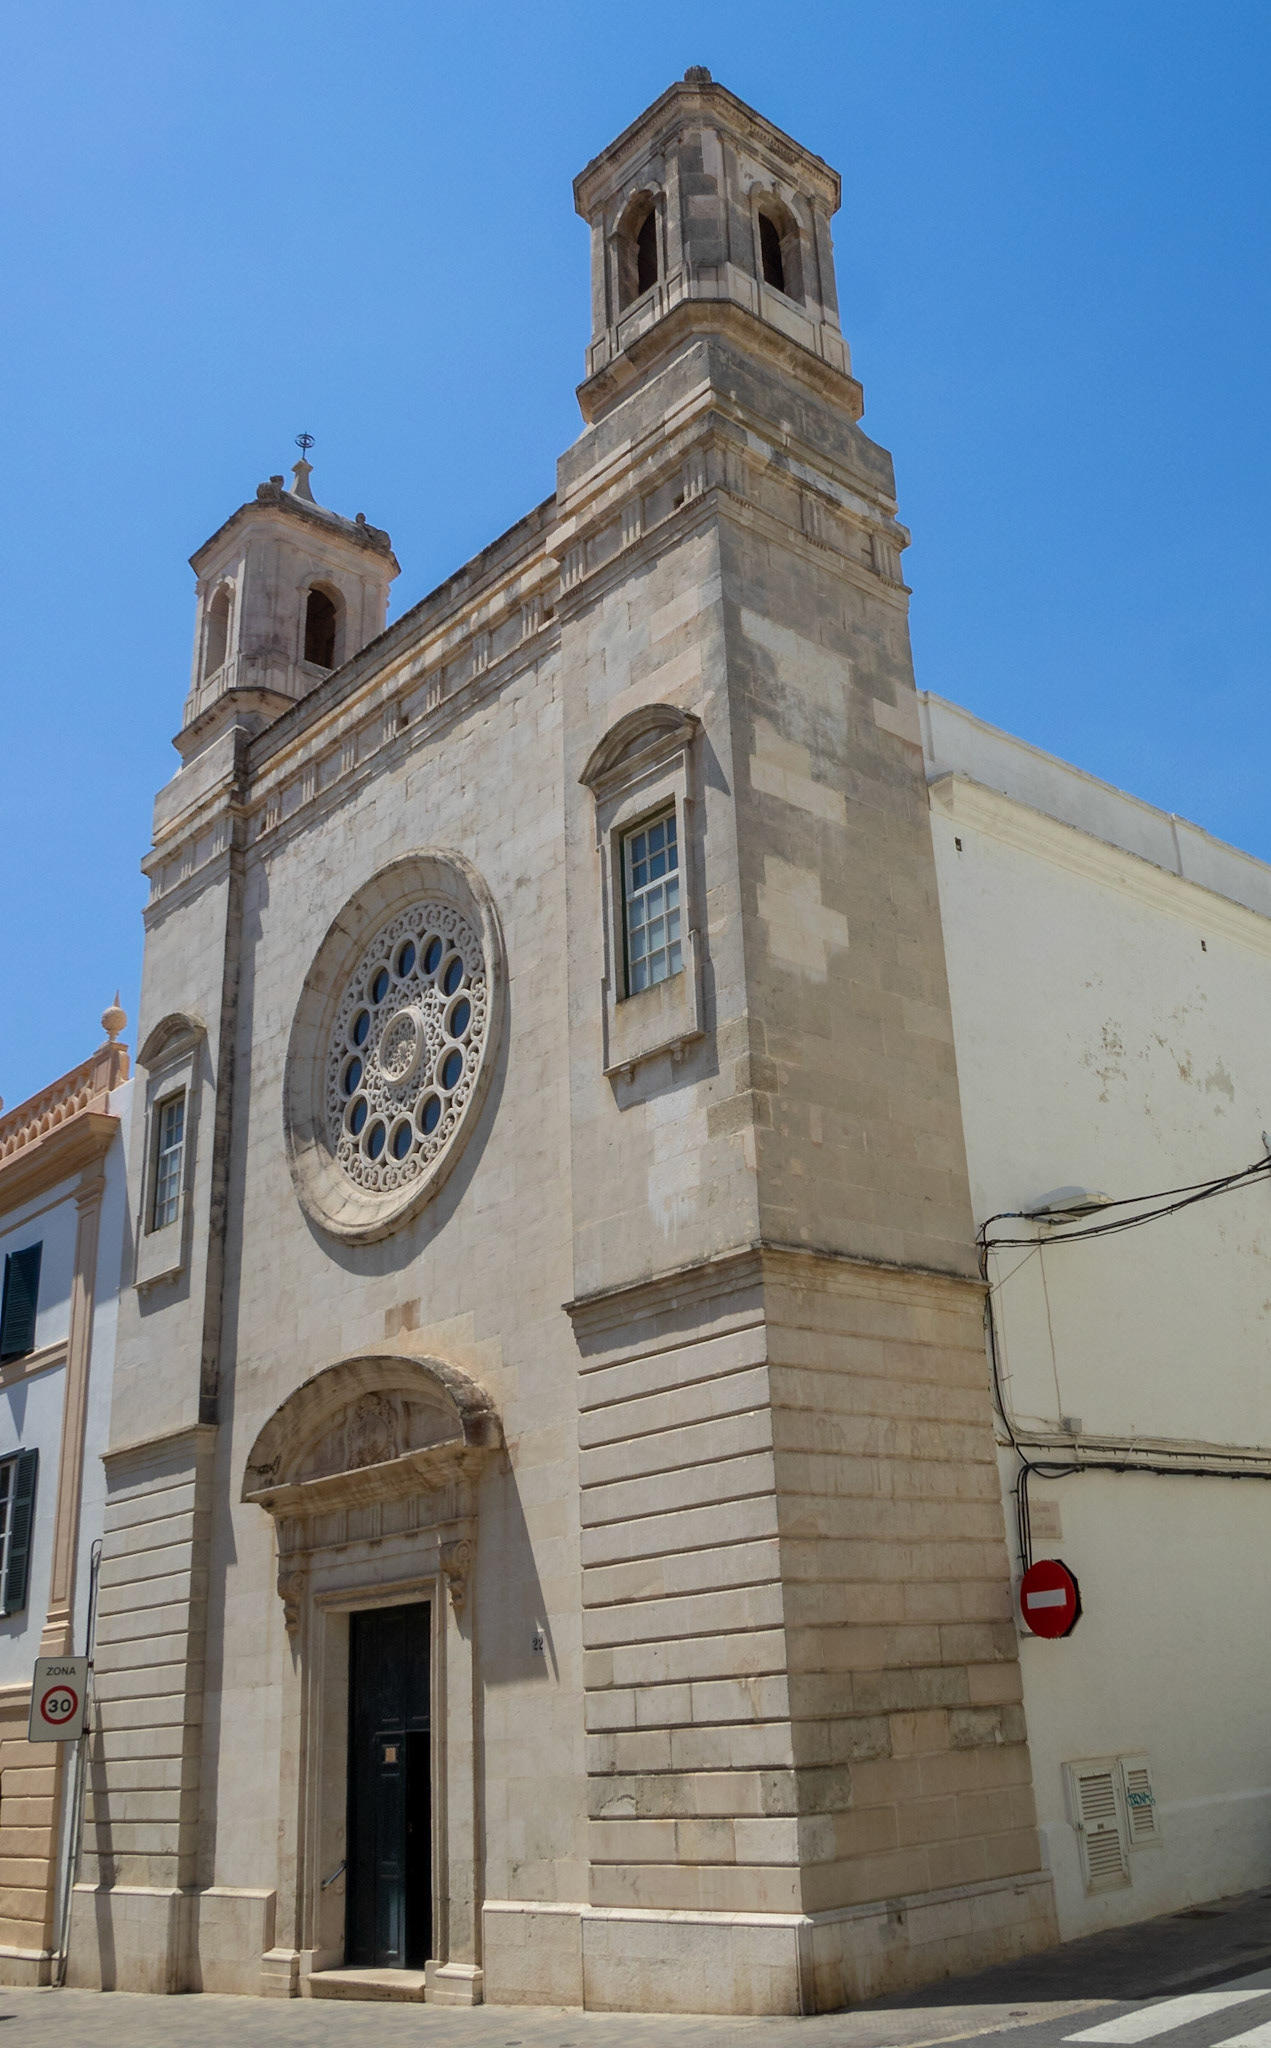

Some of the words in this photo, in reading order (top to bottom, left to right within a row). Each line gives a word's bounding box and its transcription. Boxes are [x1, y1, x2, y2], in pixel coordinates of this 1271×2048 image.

[532, 1637, 543, 1651] 22
[46, 1666, 76, 1676] ZONA
[48, 1699, 71, 1713] 30
